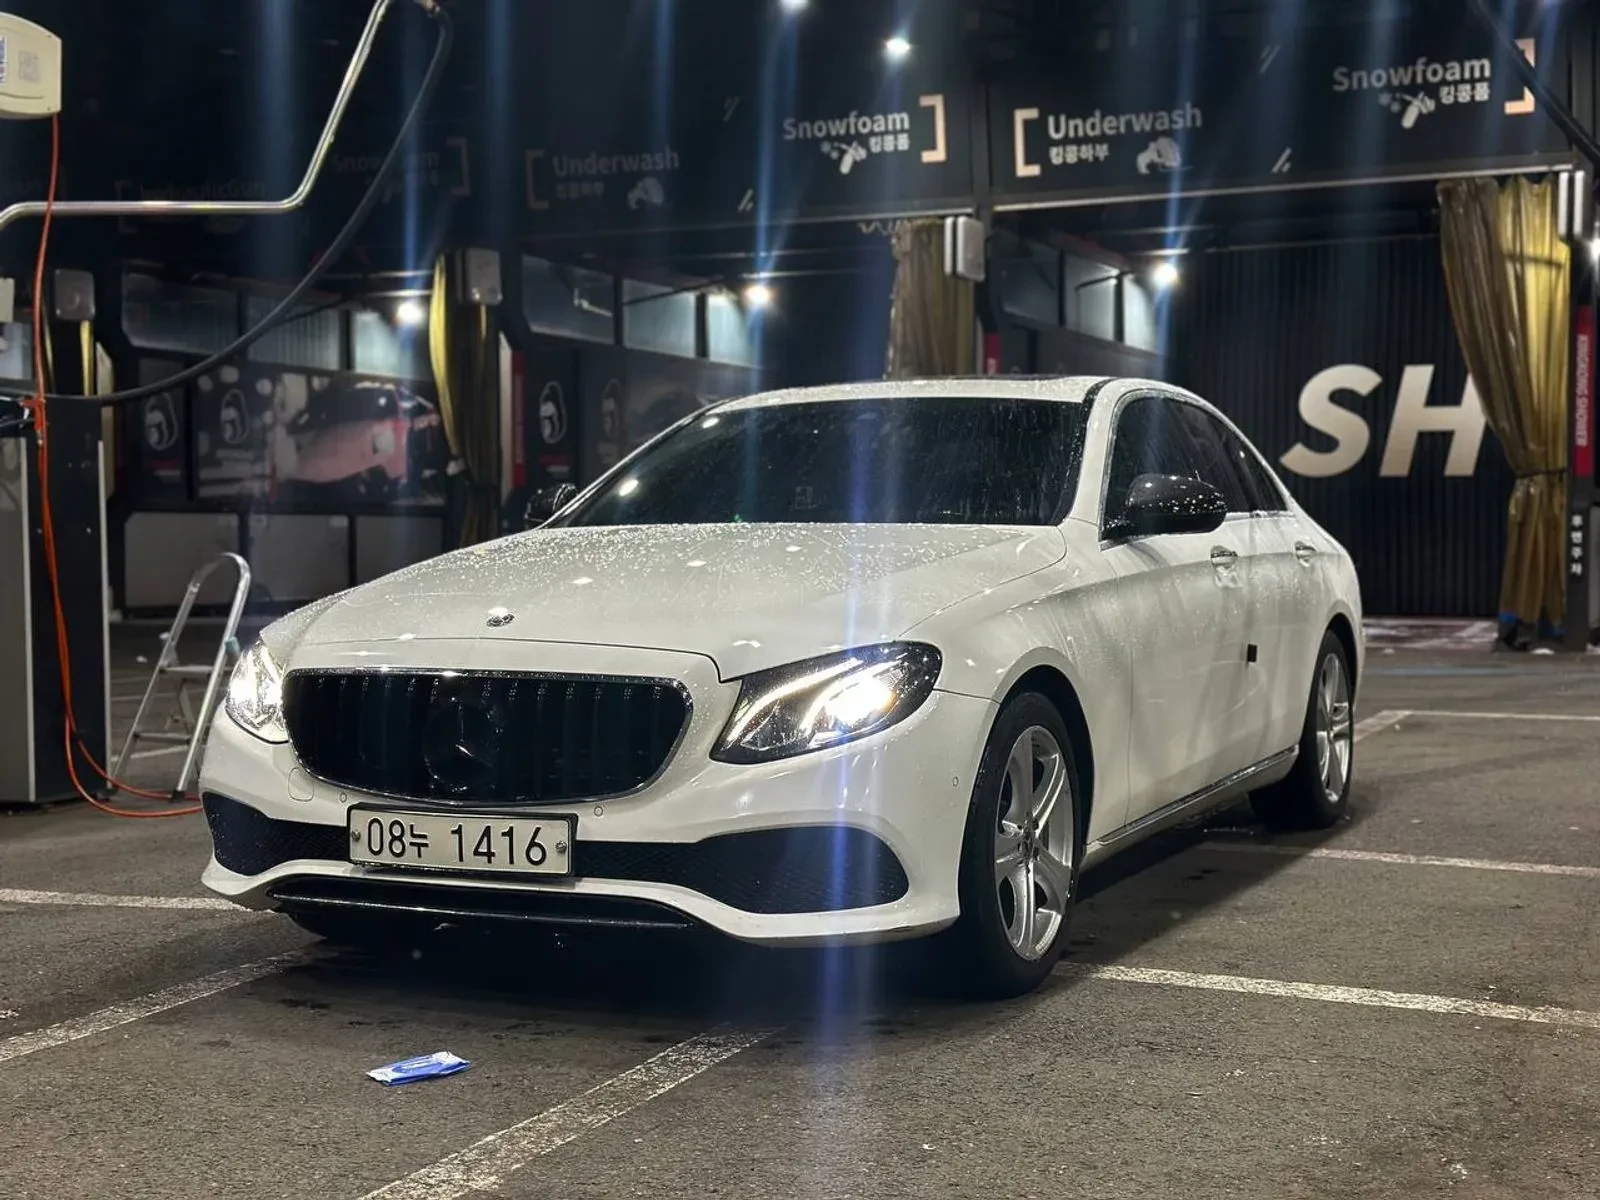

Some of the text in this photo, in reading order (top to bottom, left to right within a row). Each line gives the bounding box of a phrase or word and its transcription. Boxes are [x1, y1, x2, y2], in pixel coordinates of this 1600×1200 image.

[1333, 57, 1491, 92] Snowfoam
[783, 110, 910, 141] Snowfoam
[1048, 103, 1203, 140] Underwash
[552, 145, 680, 177] Underwash
[367, 817, 548, 866] 08누 1416
